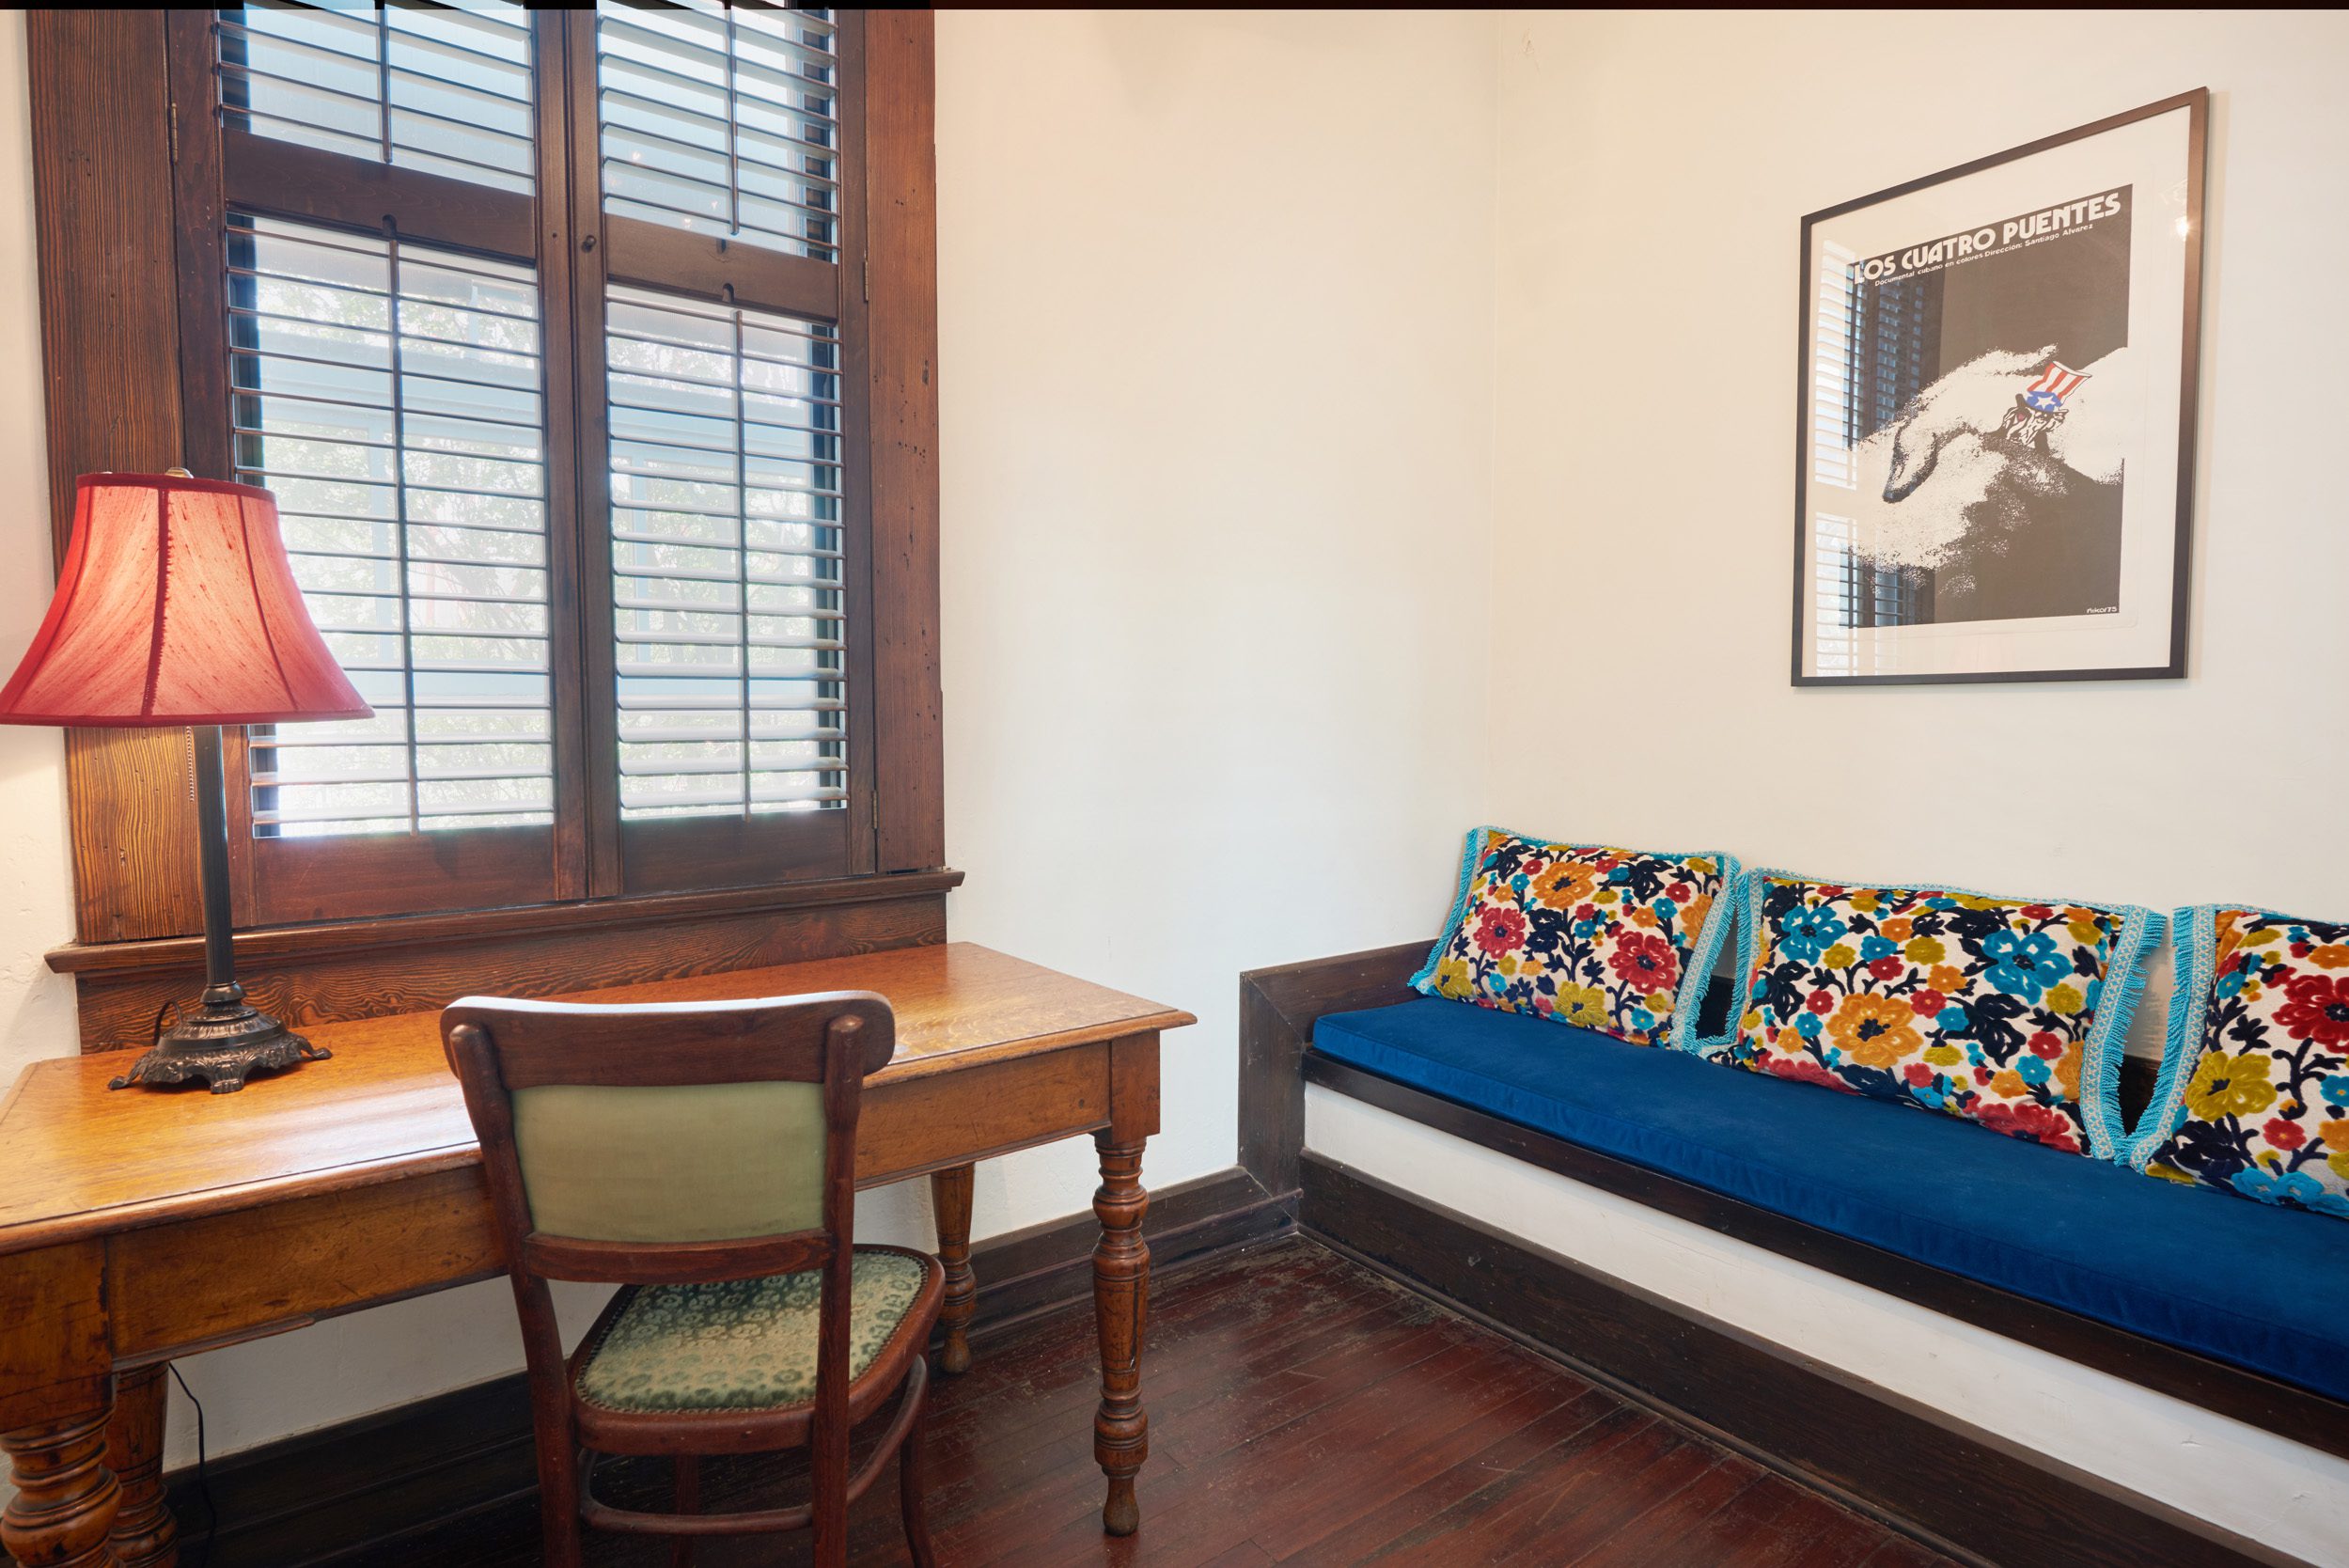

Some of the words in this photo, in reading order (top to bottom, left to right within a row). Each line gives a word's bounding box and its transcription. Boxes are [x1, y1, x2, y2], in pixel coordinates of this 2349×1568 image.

[1855, 255, 1896, 285] LOS
[1902, 228, 1997, 270] CUATRO
[2003, 192, 2121, 244] PUENTES
[1874, 271, 1915, 287] Documental
[1918, 263, 1943, 274] cubano
[1956, 253, 1983, 265] colores
[2025, 232, 2059, 246] Santiago
